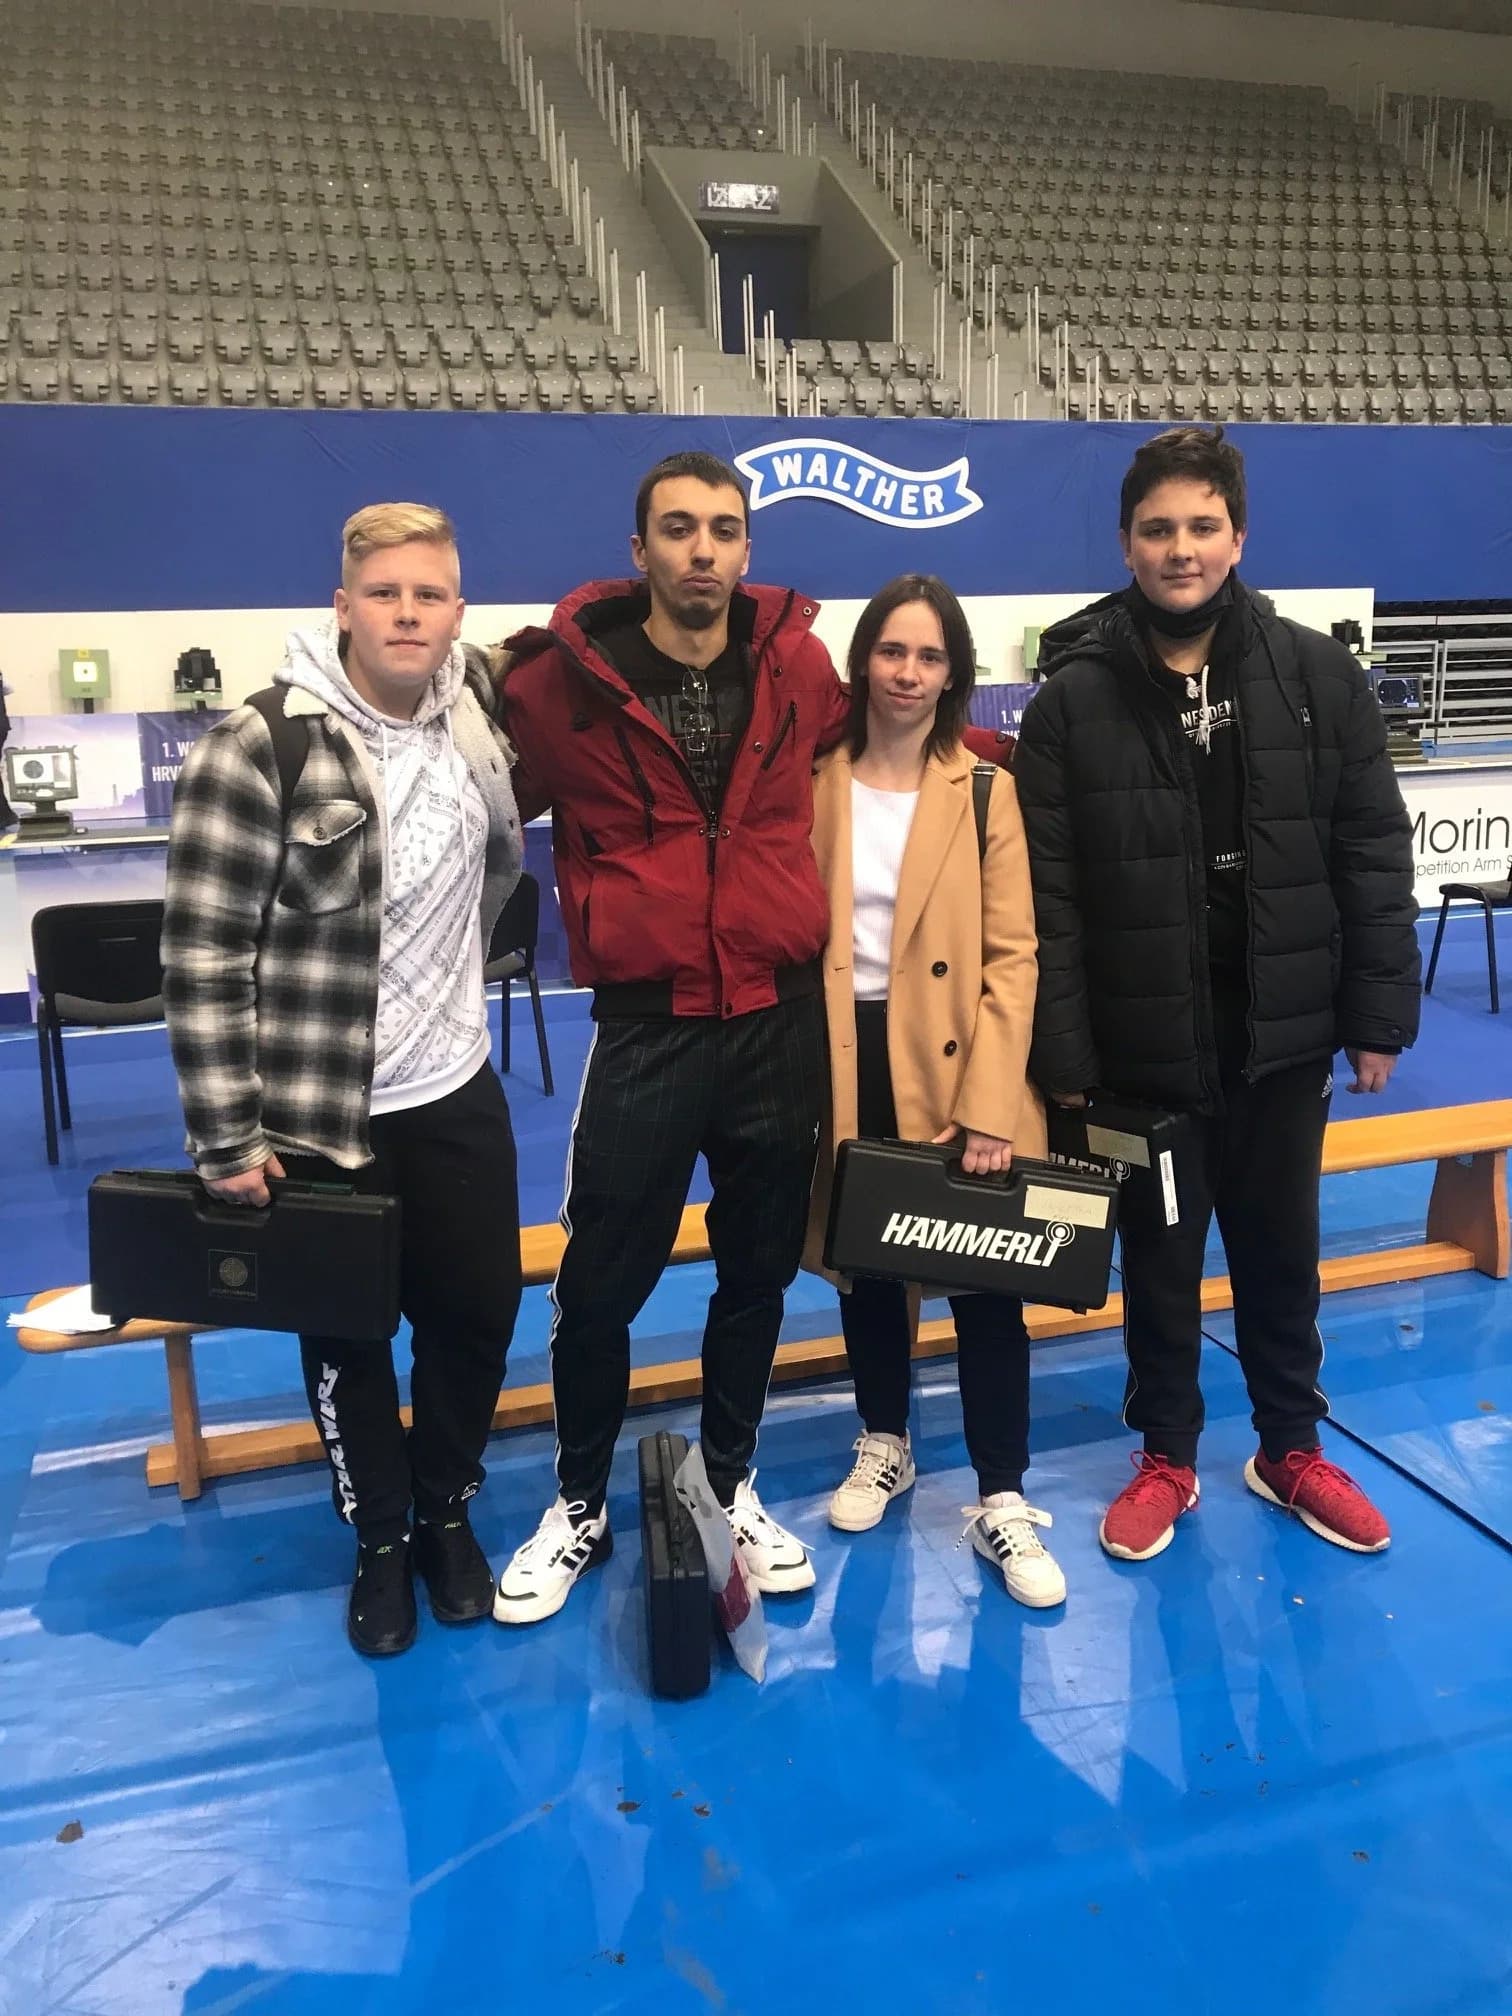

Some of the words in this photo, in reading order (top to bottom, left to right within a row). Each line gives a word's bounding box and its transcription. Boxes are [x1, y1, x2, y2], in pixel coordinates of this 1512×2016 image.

[771, 453, 945, 516] WALTHER
[1001, 710, 1011, 724] 1.
[162, 742, 174, 758] 1.
[177, 741, 195, 757] W
[152, 765, 183, 782] HRV
[1473, 857, 1502, 872] Arm
[880, 1212, 1075, 1267] HÄMMERLI
[317, 1362, 341, 1440] WARS
